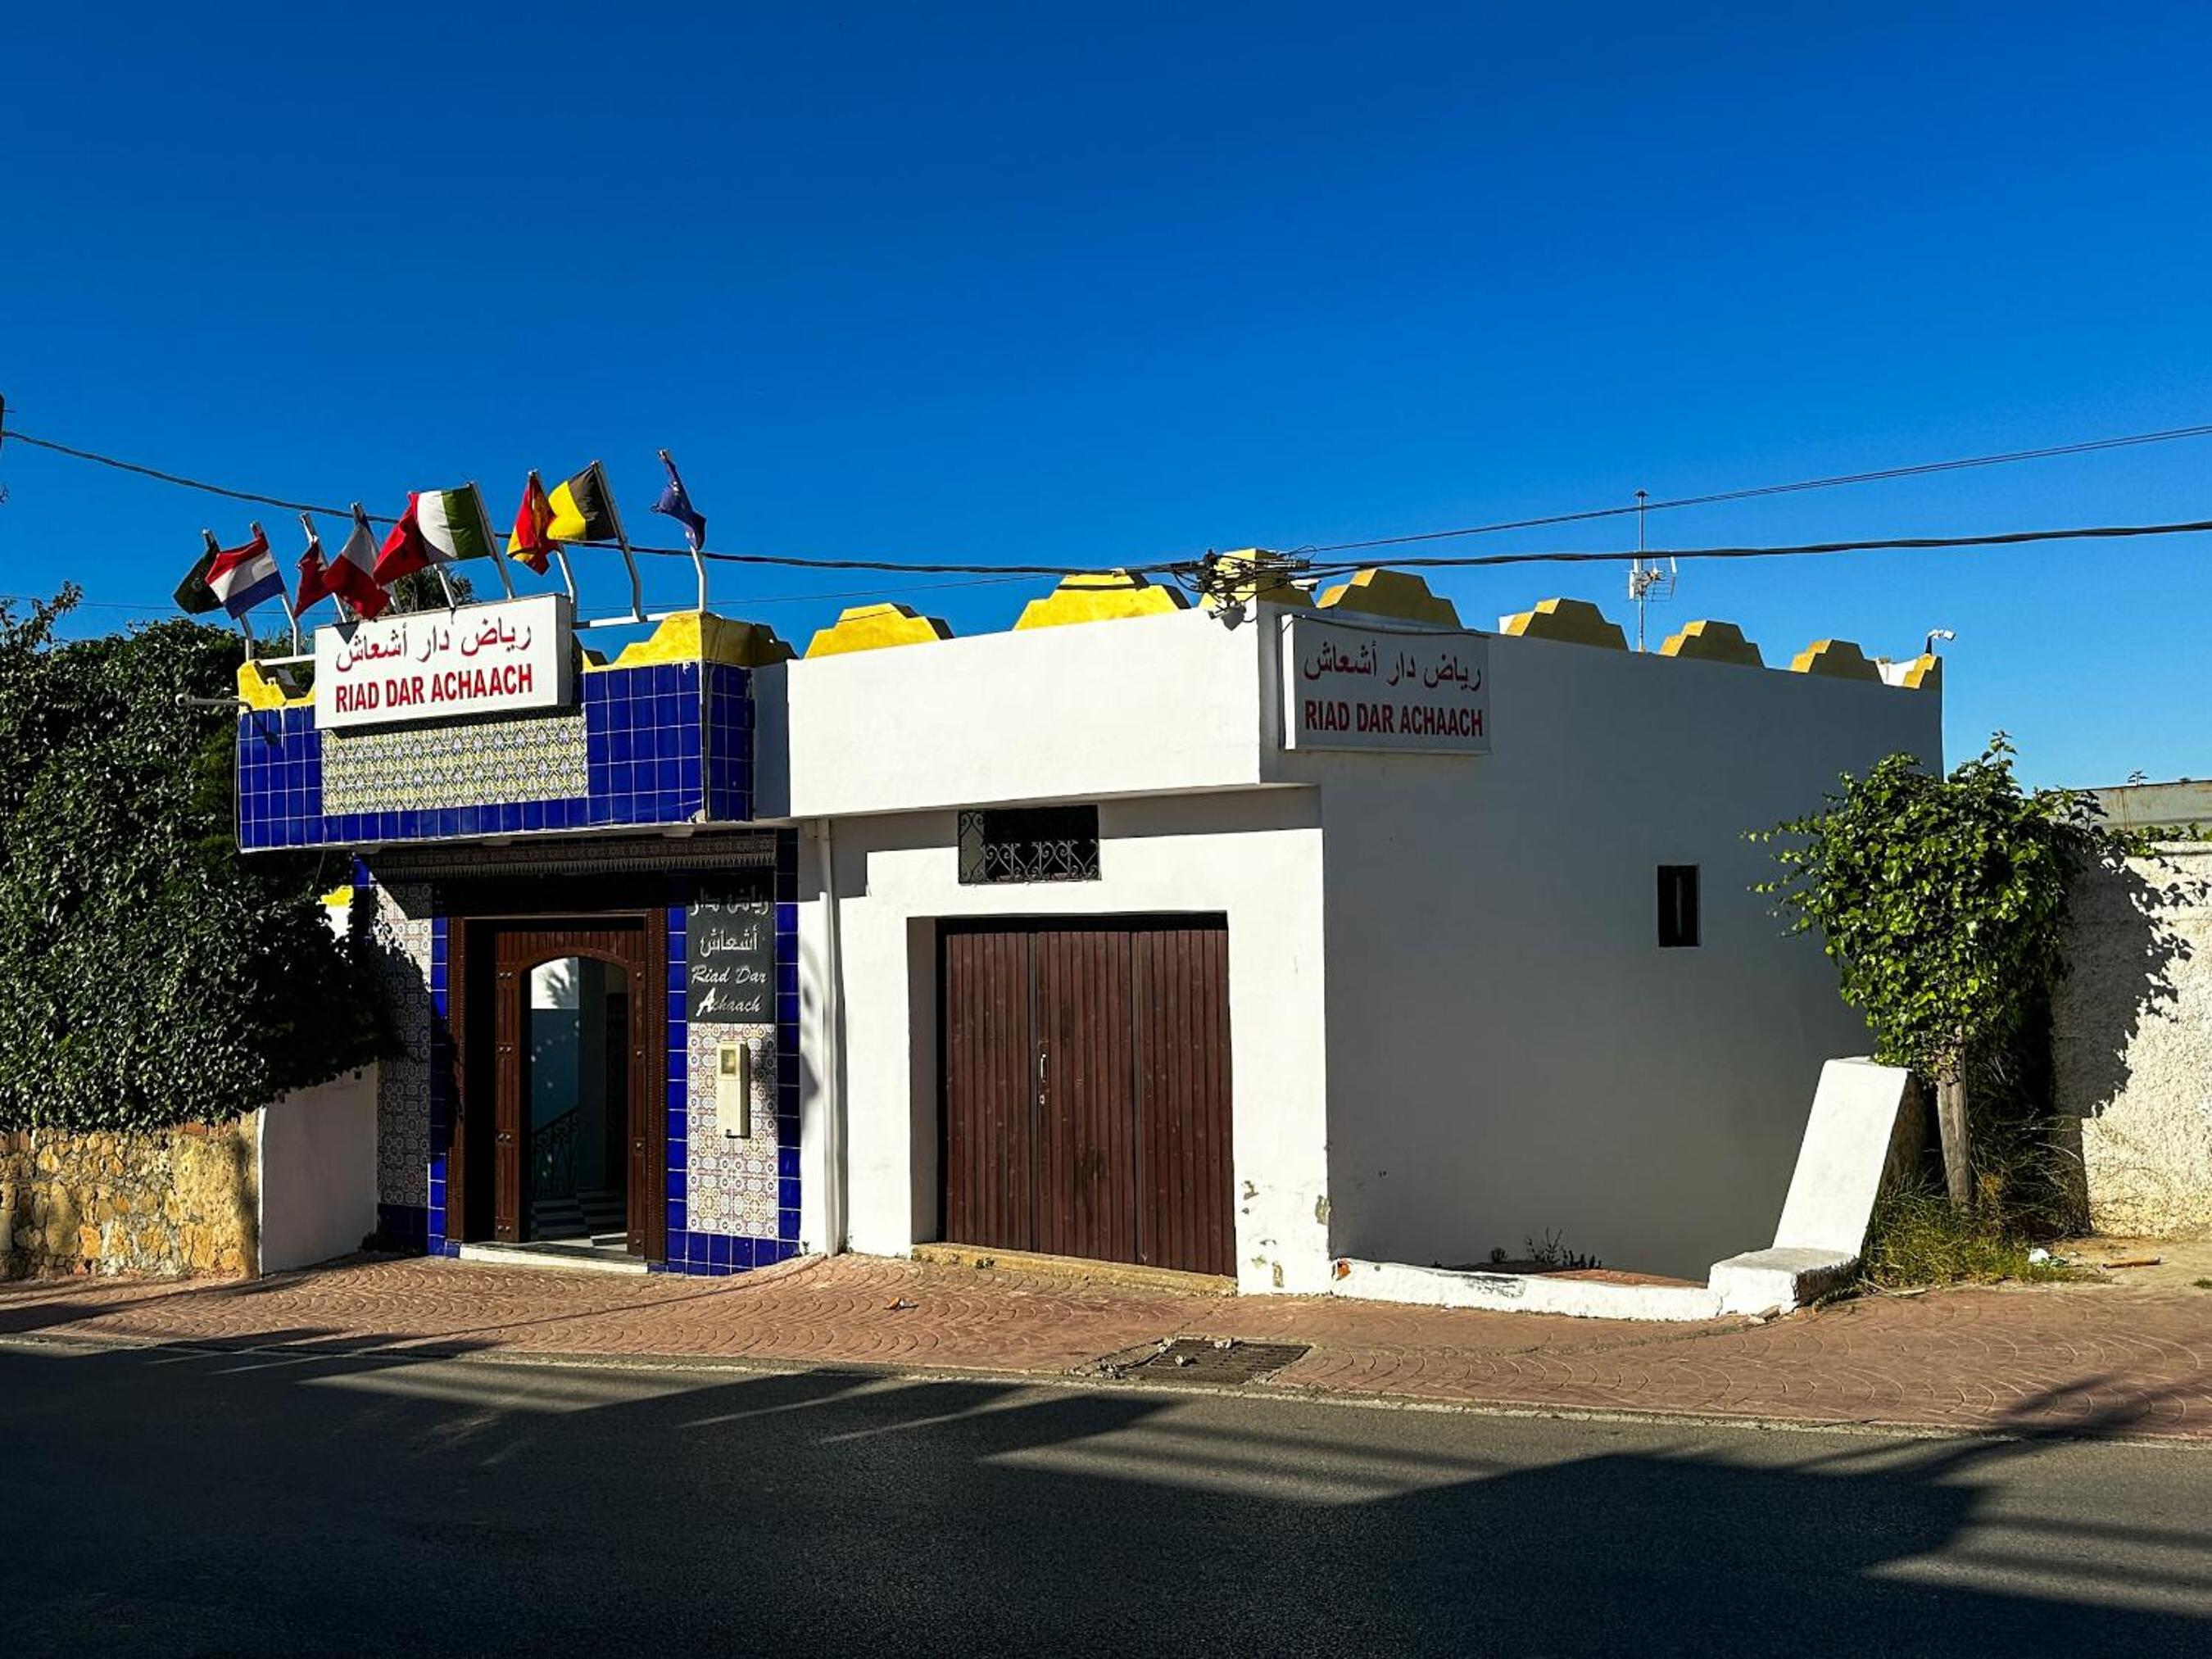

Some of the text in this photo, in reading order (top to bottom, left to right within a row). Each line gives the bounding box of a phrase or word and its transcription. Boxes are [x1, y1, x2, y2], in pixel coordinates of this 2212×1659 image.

[335, 617, 532, 673] رياض دار أشعاش
[1304, 640, 1481, 691] رياض دار أشعاش
[335, 663, 533, 713] RIAD DAR ACHAACH
[1304, 700, 1484, 737] RIAD DAR ACHAACH
[700, 924, 758, 958] أشعاش
[691, 963, 768, 985] Riad Dar
[696, 987, 763, 1017] Achaach
